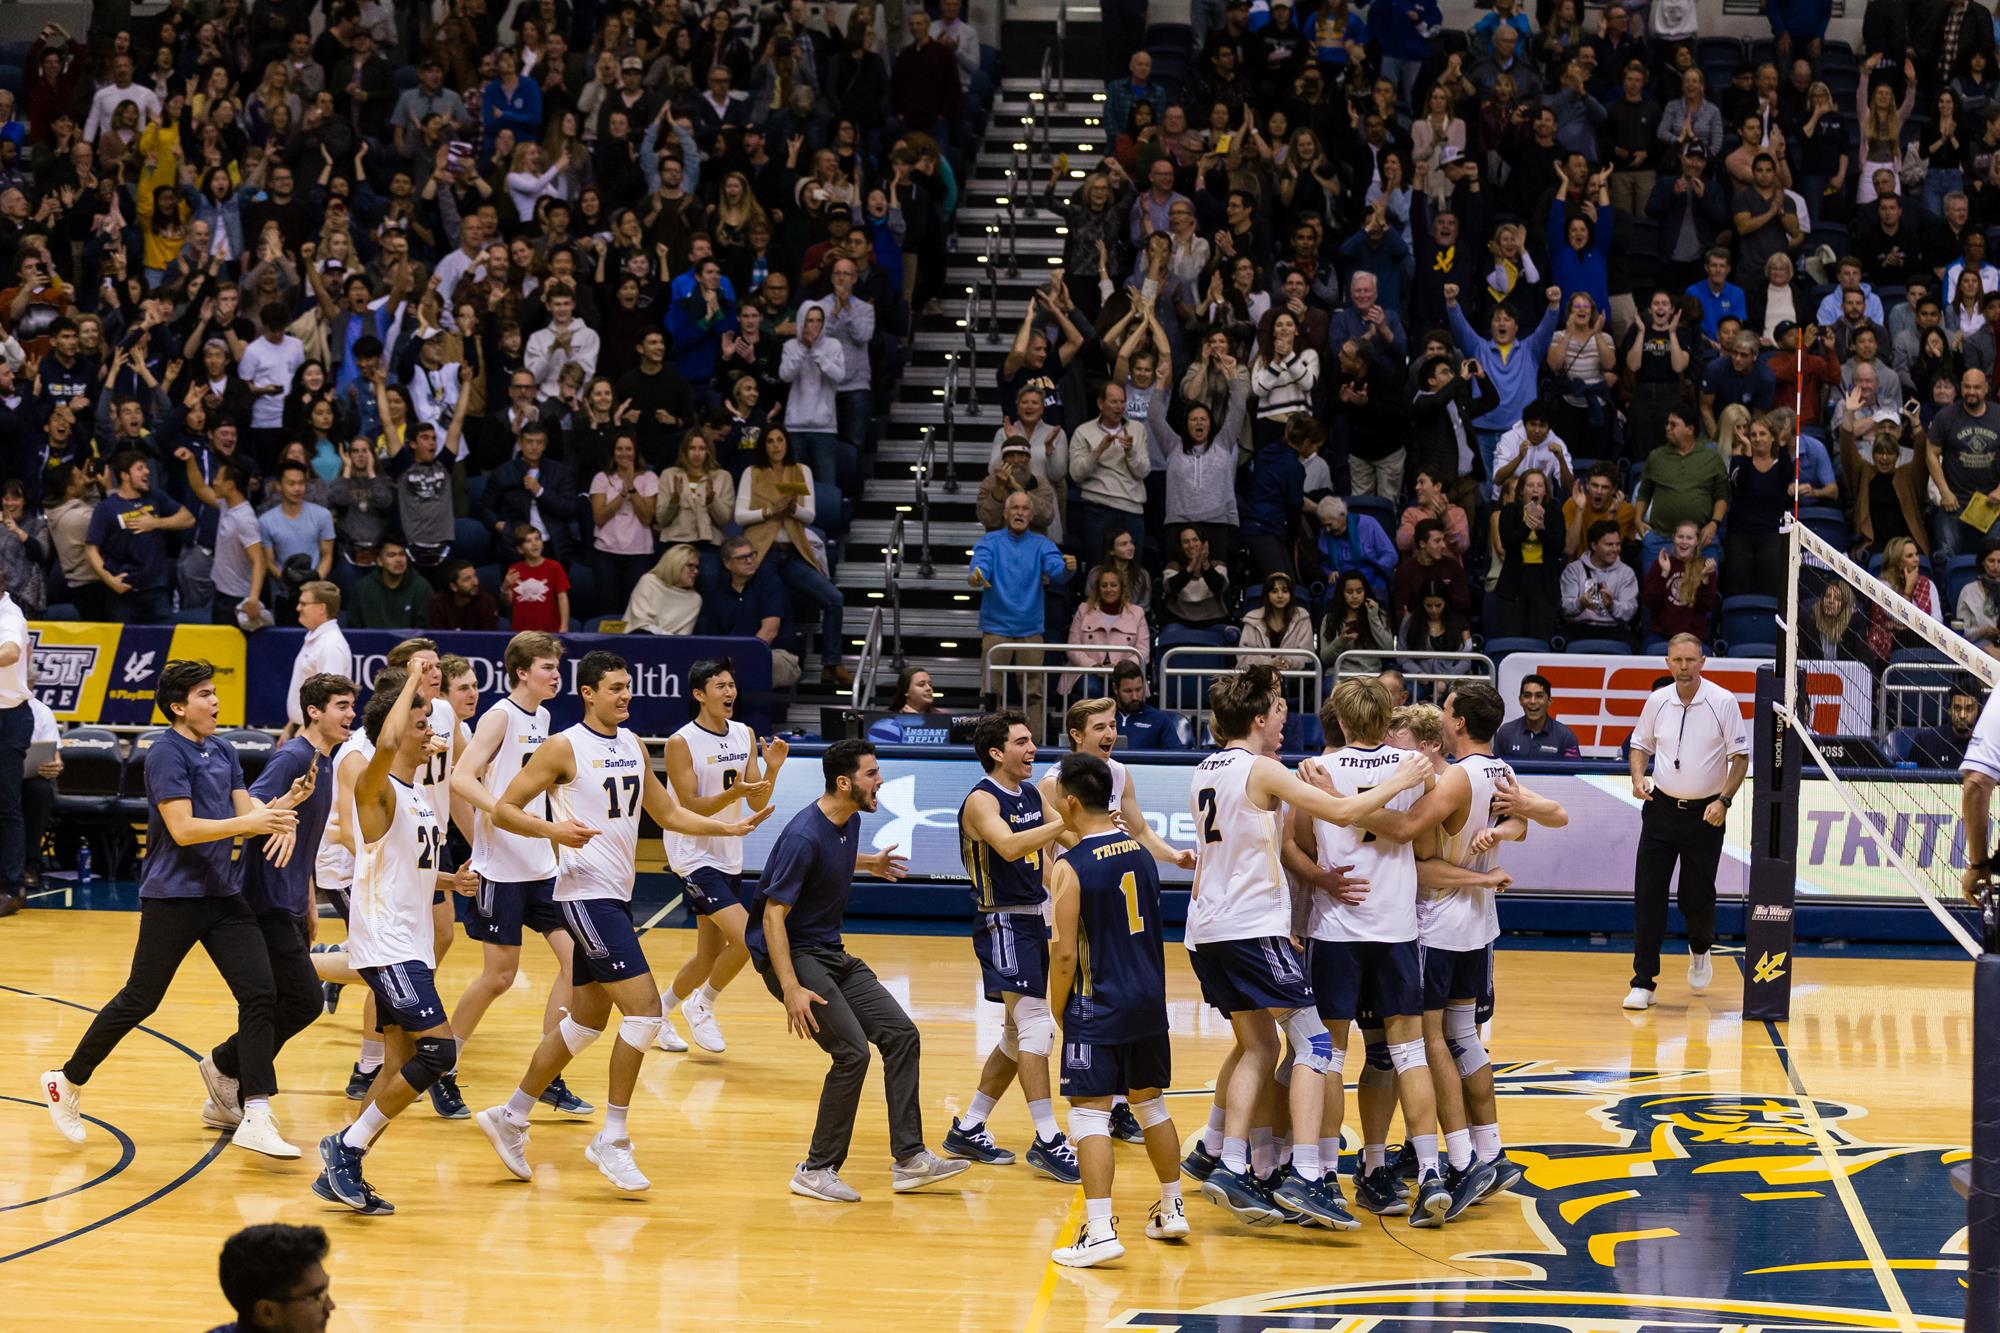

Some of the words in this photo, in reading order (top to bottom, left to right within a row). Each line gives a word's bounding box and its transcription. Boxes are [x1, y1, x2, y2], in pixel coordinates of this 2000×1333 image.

[1537, 665, 1844, 747] ES
[1198, 757, 1236, 771] RITNS
[1339, 753, 1400, 769] TRITONS
[602, 775, 641, 819] 17
[1198, 787, 1223, 844] 2
[930, 873, 972, 881] DAKTRONI
[1119, 871, 1145, 936] 1
